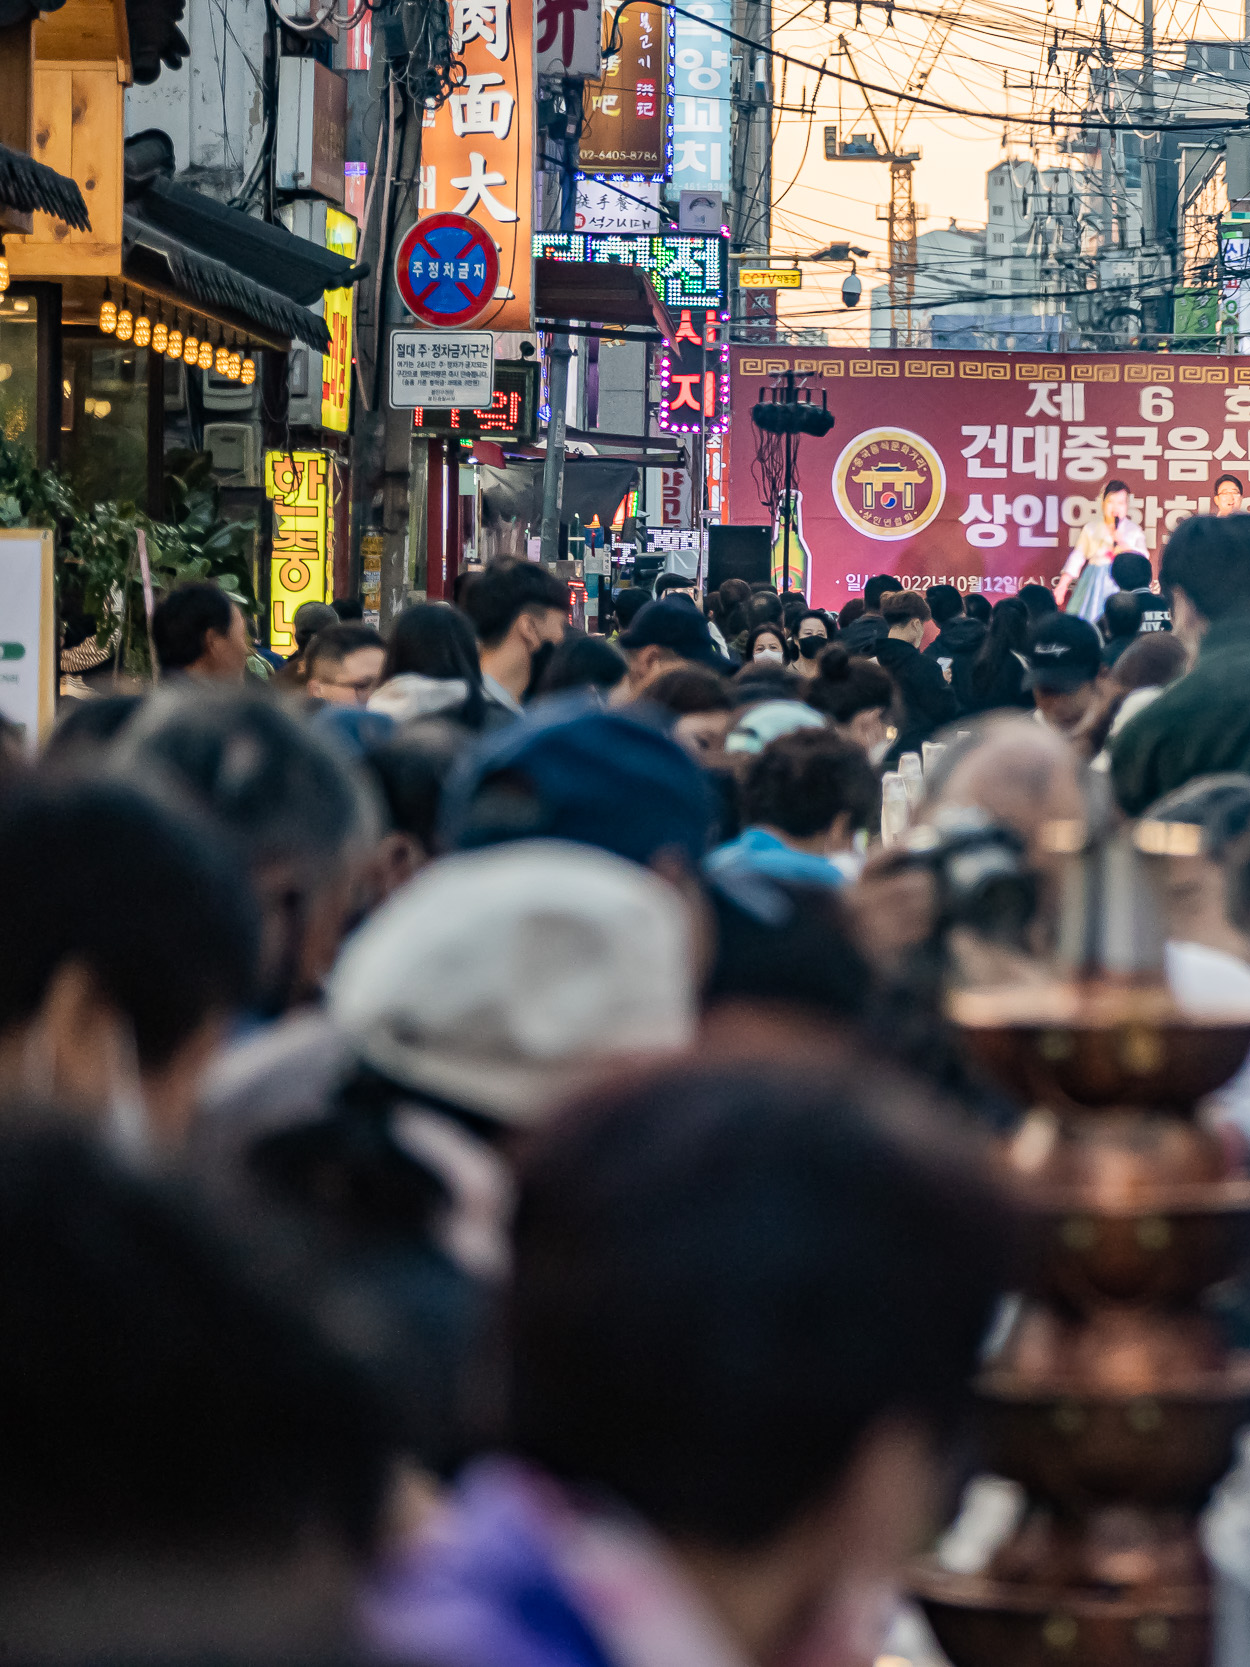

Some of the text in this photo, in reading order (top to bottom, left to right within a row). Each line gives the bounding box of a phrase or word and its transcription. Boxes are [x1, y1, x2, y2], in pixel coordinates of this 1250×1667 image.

[412, 261, 485, 280] 주정차금지
[396, 343, 415, 358] 절대
[1026, 383, 1085, 421] 제
[1139, 386, 1174, 422] 6
